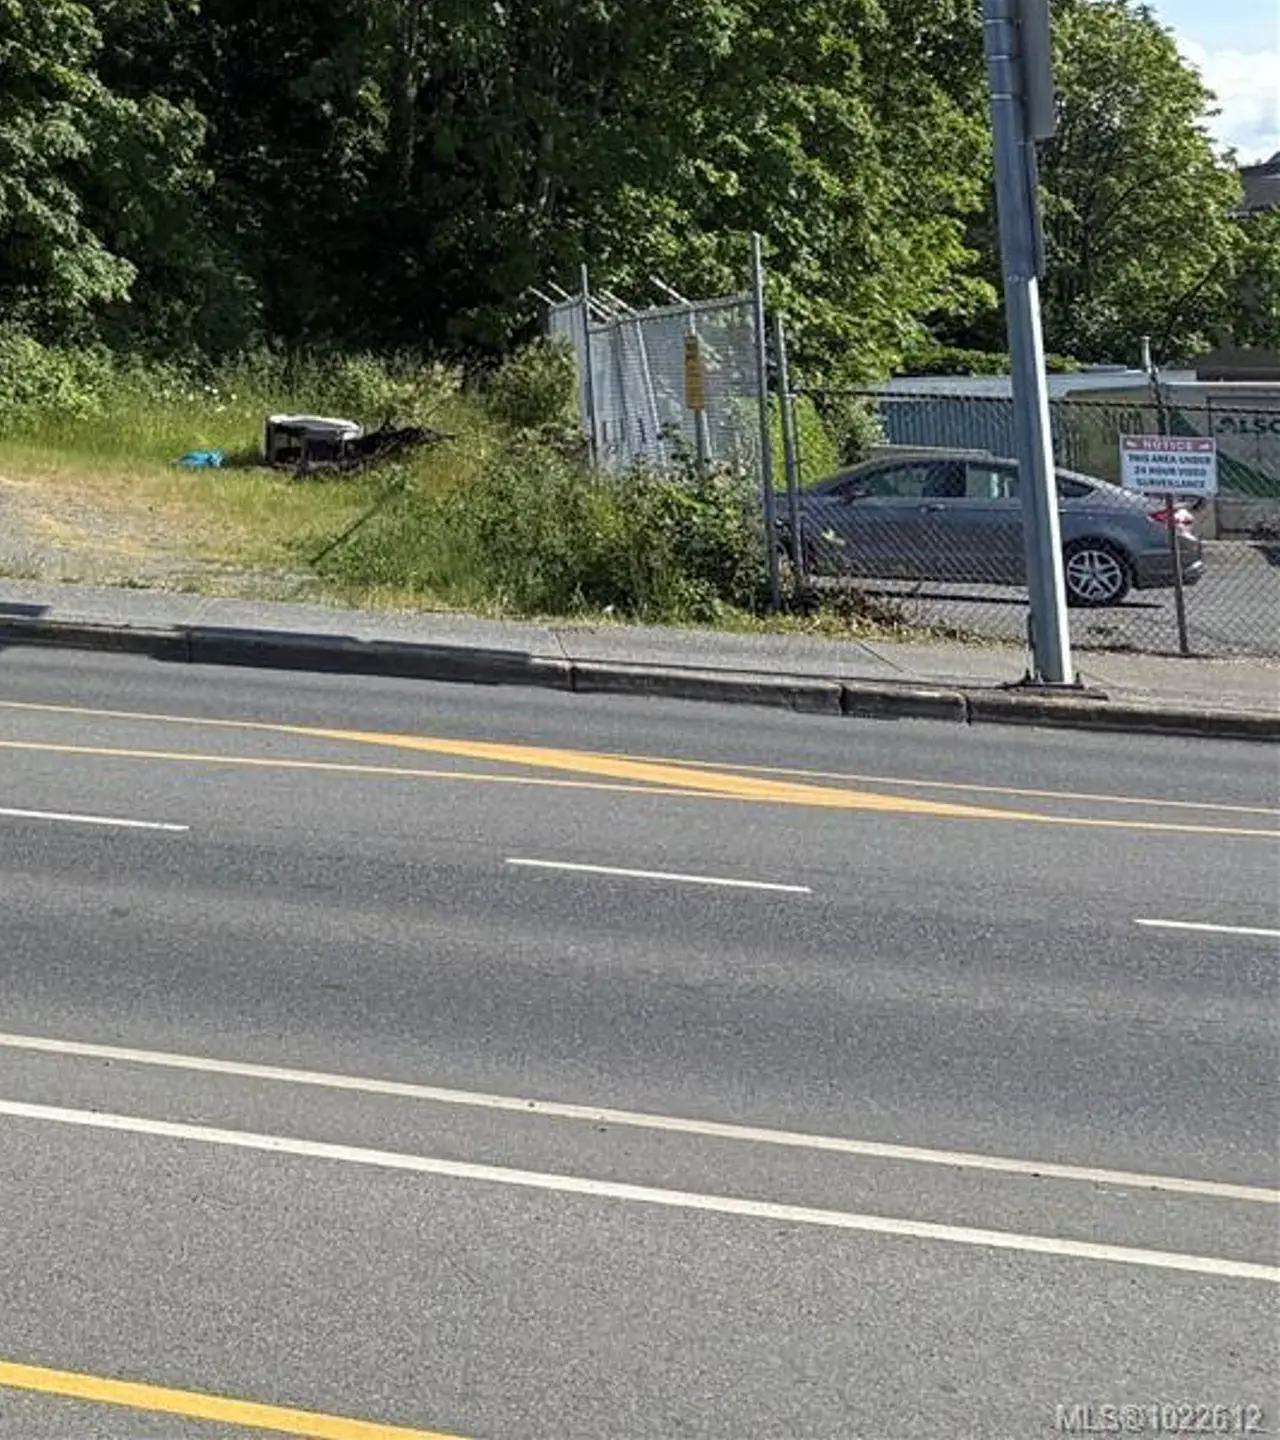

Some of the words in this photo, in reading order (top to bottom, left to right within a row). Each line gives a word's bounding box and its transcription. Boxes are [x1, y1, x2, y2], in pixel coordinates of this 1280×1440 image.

[1142, 440, 1193, 451] NOTICE
[1128, 454, 1149, 462] THIS
[1152, 454, 1177, 463] AREA
[1179, 455, 1211, 464] UNDER
[1133, 465, 1146, 475] 24
[1148, 466, 1176, 475] HOUR
[1178, 467, 1207, 477] VIDEO
